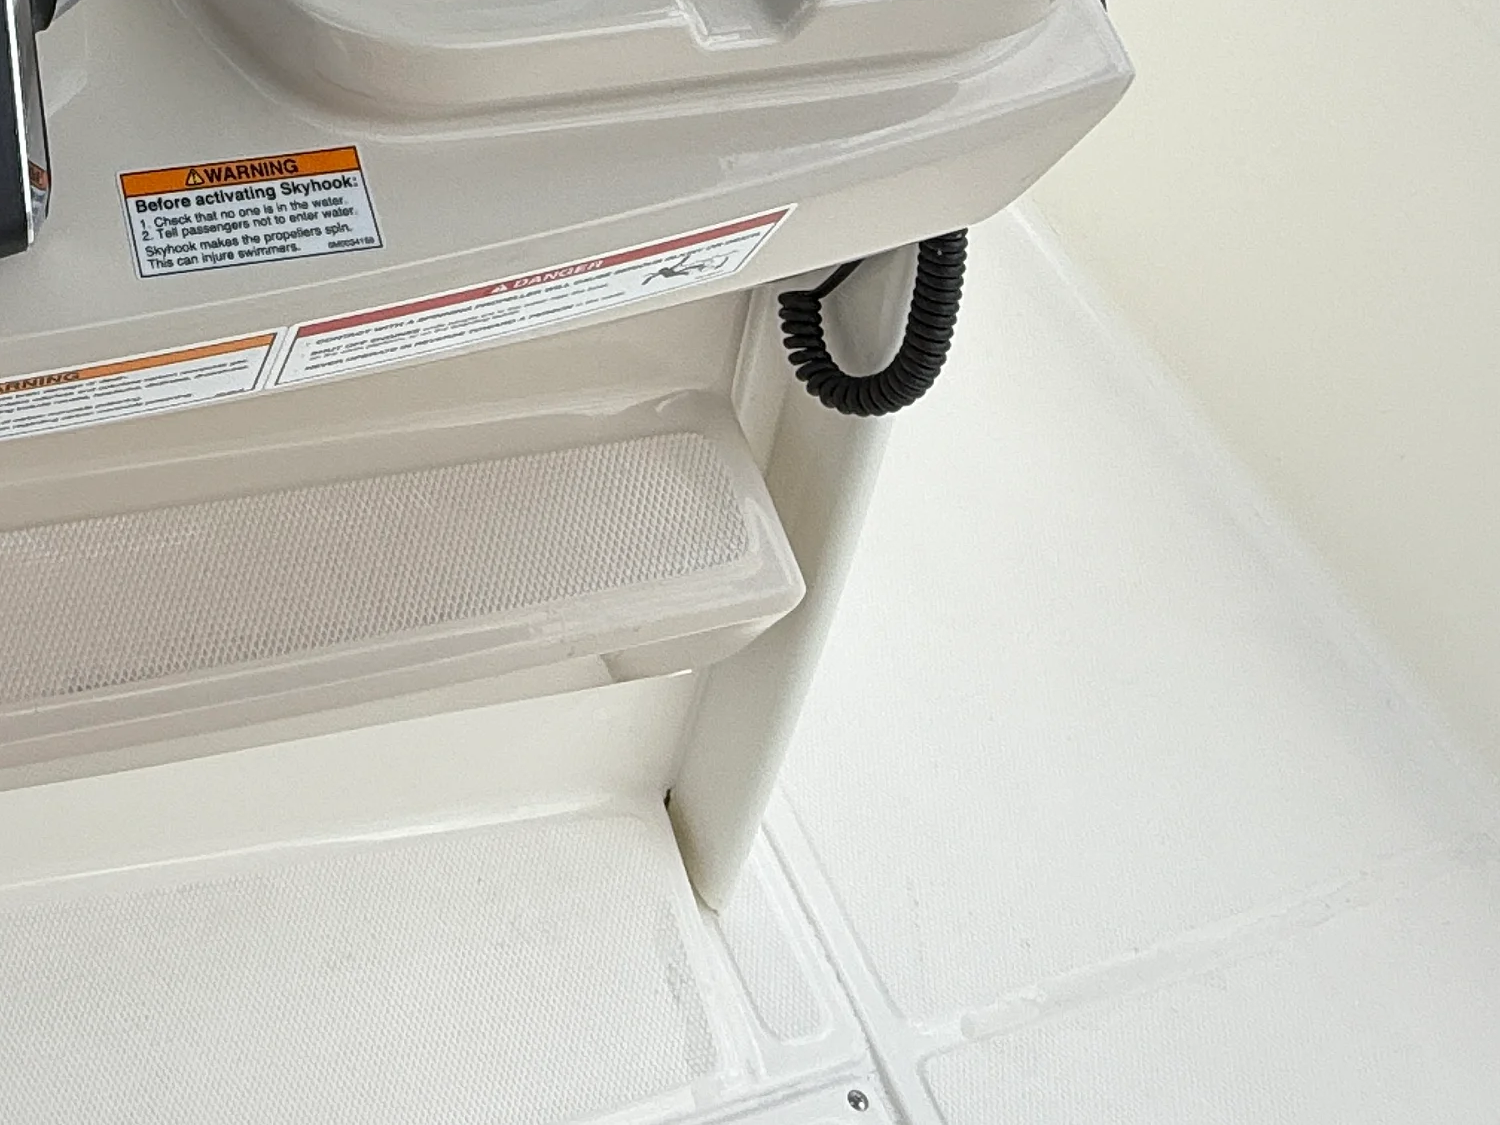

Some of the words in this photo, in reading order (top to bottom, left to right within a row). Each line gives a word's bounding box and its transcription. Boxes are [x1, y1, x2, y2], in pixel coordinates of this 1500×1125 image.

[203, 159, 299, 183] WARNING
[136, 197, 191, 213] Before
[196, 187, 276, 206] activating
[280, 175, 358, 195] Skyhook:
[142, 231, 154, 241] 2.
[156, 227, 178, 239] Tell
[182, 221, 250, 239] passengers
[252, 216, 272, 227] not
[274, 215, 286, 224] to
[289, 211, 318, 223] enter
[322, 206, 358, 220] water.
[154, 214, 192, 227] Check
[194, 211, 218, 223] that
[239, 207, 260, 217] one
[263, 205, 274, 214] is
[276, 203, 287, 212] in
[290, 200, 308, 211] the
[312, 196, 348, 209] water.
[145, 241, 197, 261] Skyhook
[200, 237, 239, 249] makes
[242, 234, 260, 245] the
[147, 257, 174, 269] This
[177, 256, 198, 266] can
[202, 251, 234, 264] injure
[514, 260, 604, 288] DANGER
